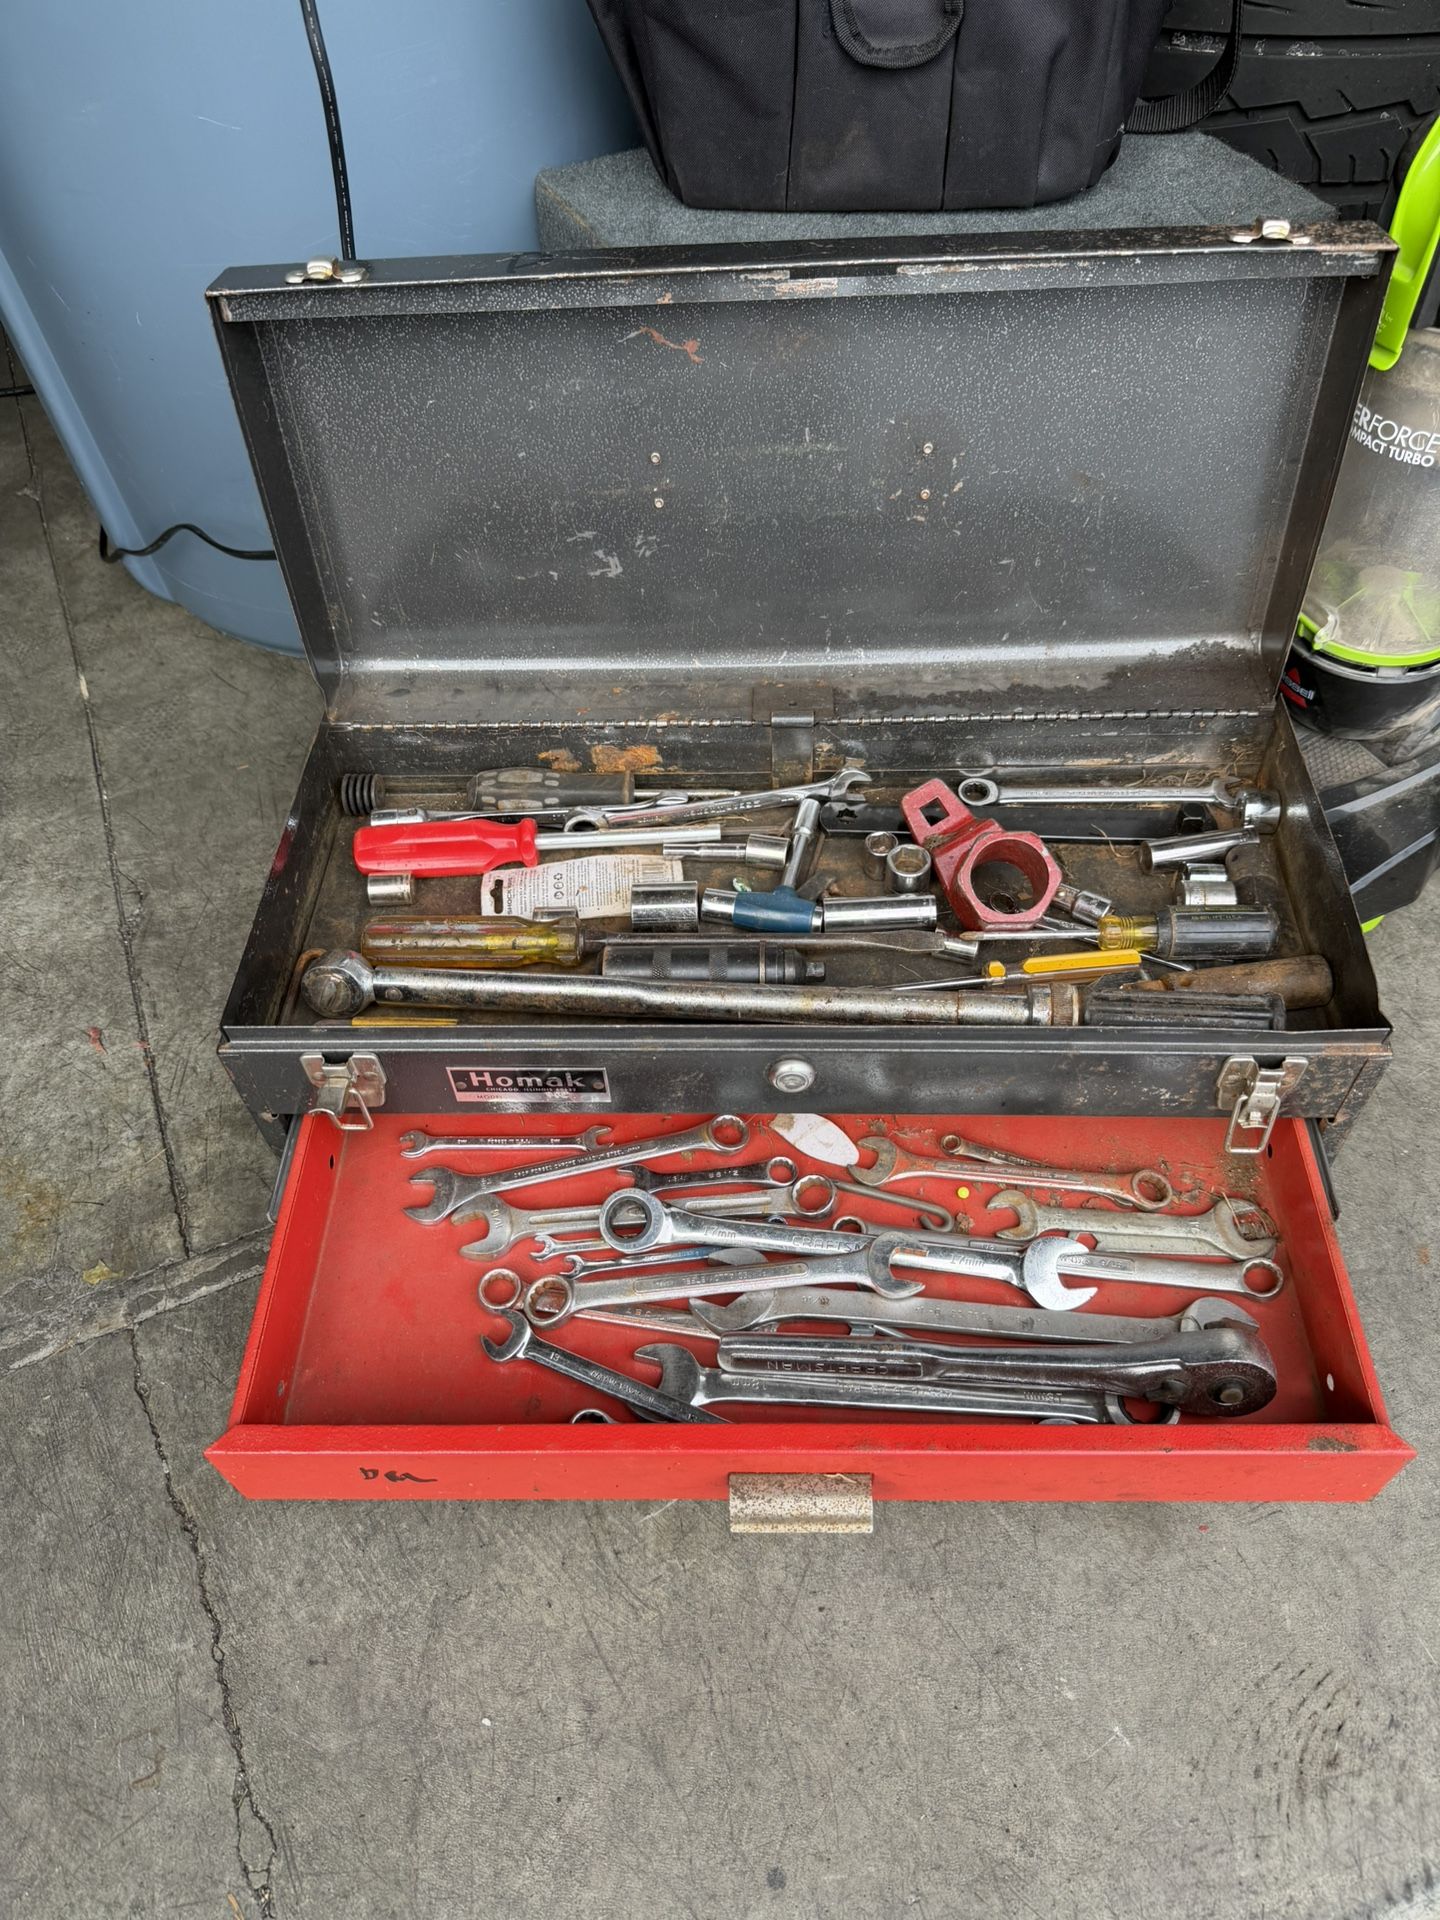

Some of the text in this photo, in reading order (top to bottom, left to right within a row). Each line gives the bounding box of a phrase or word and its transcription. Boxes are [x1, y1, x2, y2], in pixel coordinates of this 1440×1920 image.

[1350, 427, 1435, 468] MPACT TURBO
[469, 1072, 586, 1088] Homak
[703, 1225, 737, 1240] 17mm
[950, 1252, 986, 1268] 17mm
[766, 1360, 890, 1376] CRAFTSMAN
